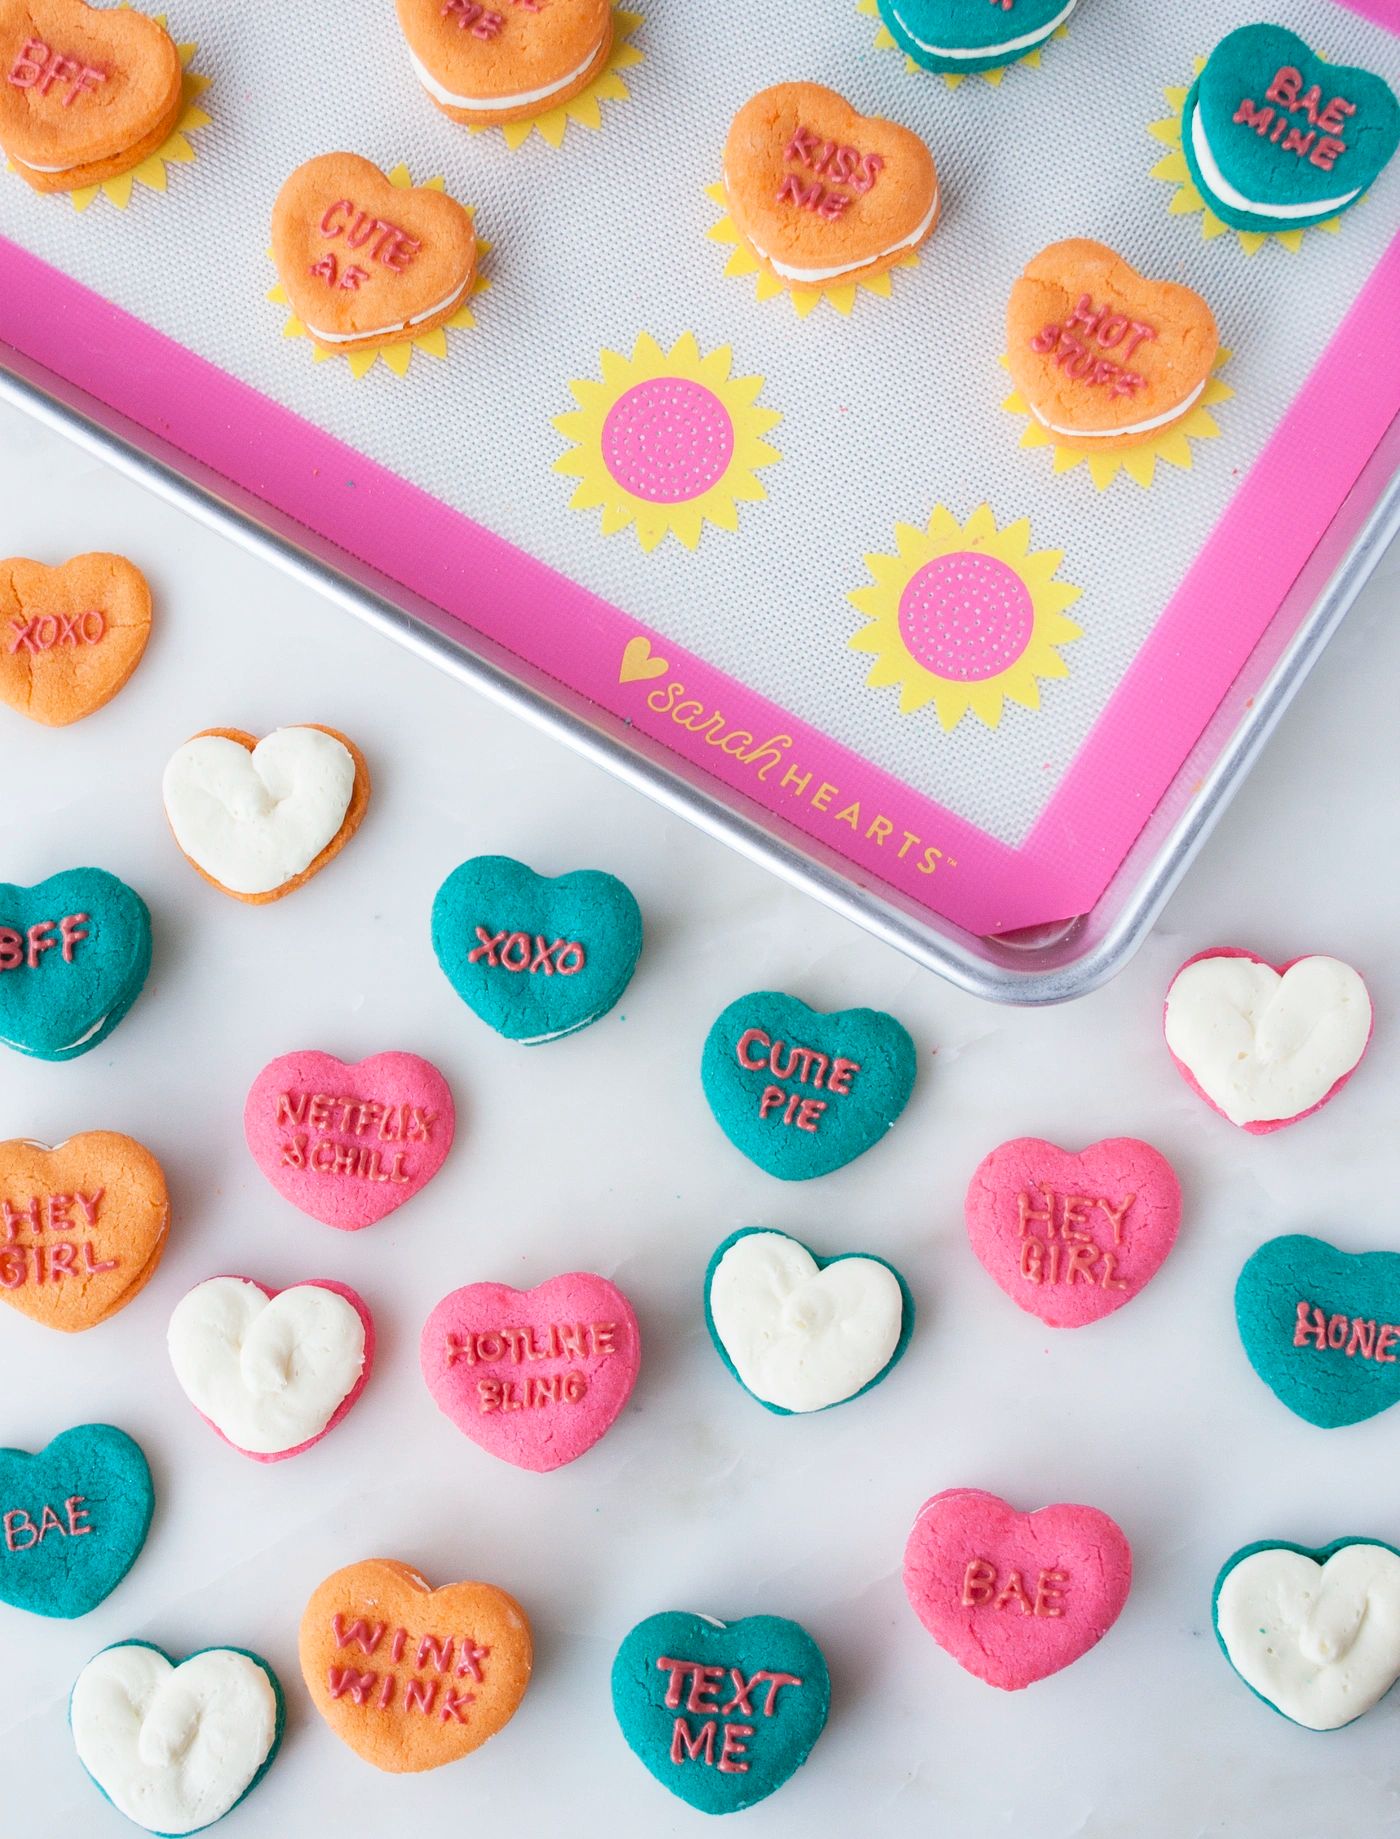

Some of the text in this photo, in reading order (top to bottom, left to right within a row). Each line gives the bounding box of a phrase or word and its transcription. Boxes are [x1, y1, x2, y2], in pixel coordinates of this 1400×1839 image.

[8, 38, 107, 107] BFF
[1265, 66, 1356, 135] BAE
[784, 127, 883, 193] KISS
[1232, 98, 1346, 171] MINE
[776, 174, 850, 221] ME
[320, 200, 422, 273] CUTE
[1065, 293, 1157, 362] HOT
[1030, 324, 1148, 400] STUFF
[9, 611, 104, 654] XOXO
[647, 682, 793, 782] sarah
[780, 763, 943, 874] HEARTS
[0, 913, 90, 971] BFF
[468, 926, 586, 976] XOXO
[736, 1028, 861, 1095] CUTIE
[276, 1092, 438, 1142] NETFLIX
[758, 1086, 827, 1131] PIE
[2, 1187, 106, 1240] HEY
[1017, 1192, 1136, 1243] HEY
[0, 1241, 120, 1289] GIRL
[1020, 1240, 1128, 1290] GIRL
[446, 1322, 617, 1367] HOTLINE
[477, 1369, 588, 1415] BLING
[3, 1495, 92, 1552] BAE
[961, 1558, 1069, 1618] BAE
[332, 1612, 490, 1683] WINK
[328, 1665, 477, 1725] WINK
[656, 1656, 802, 1717] TEXT
[670, 1717, 756, 1774] ME
